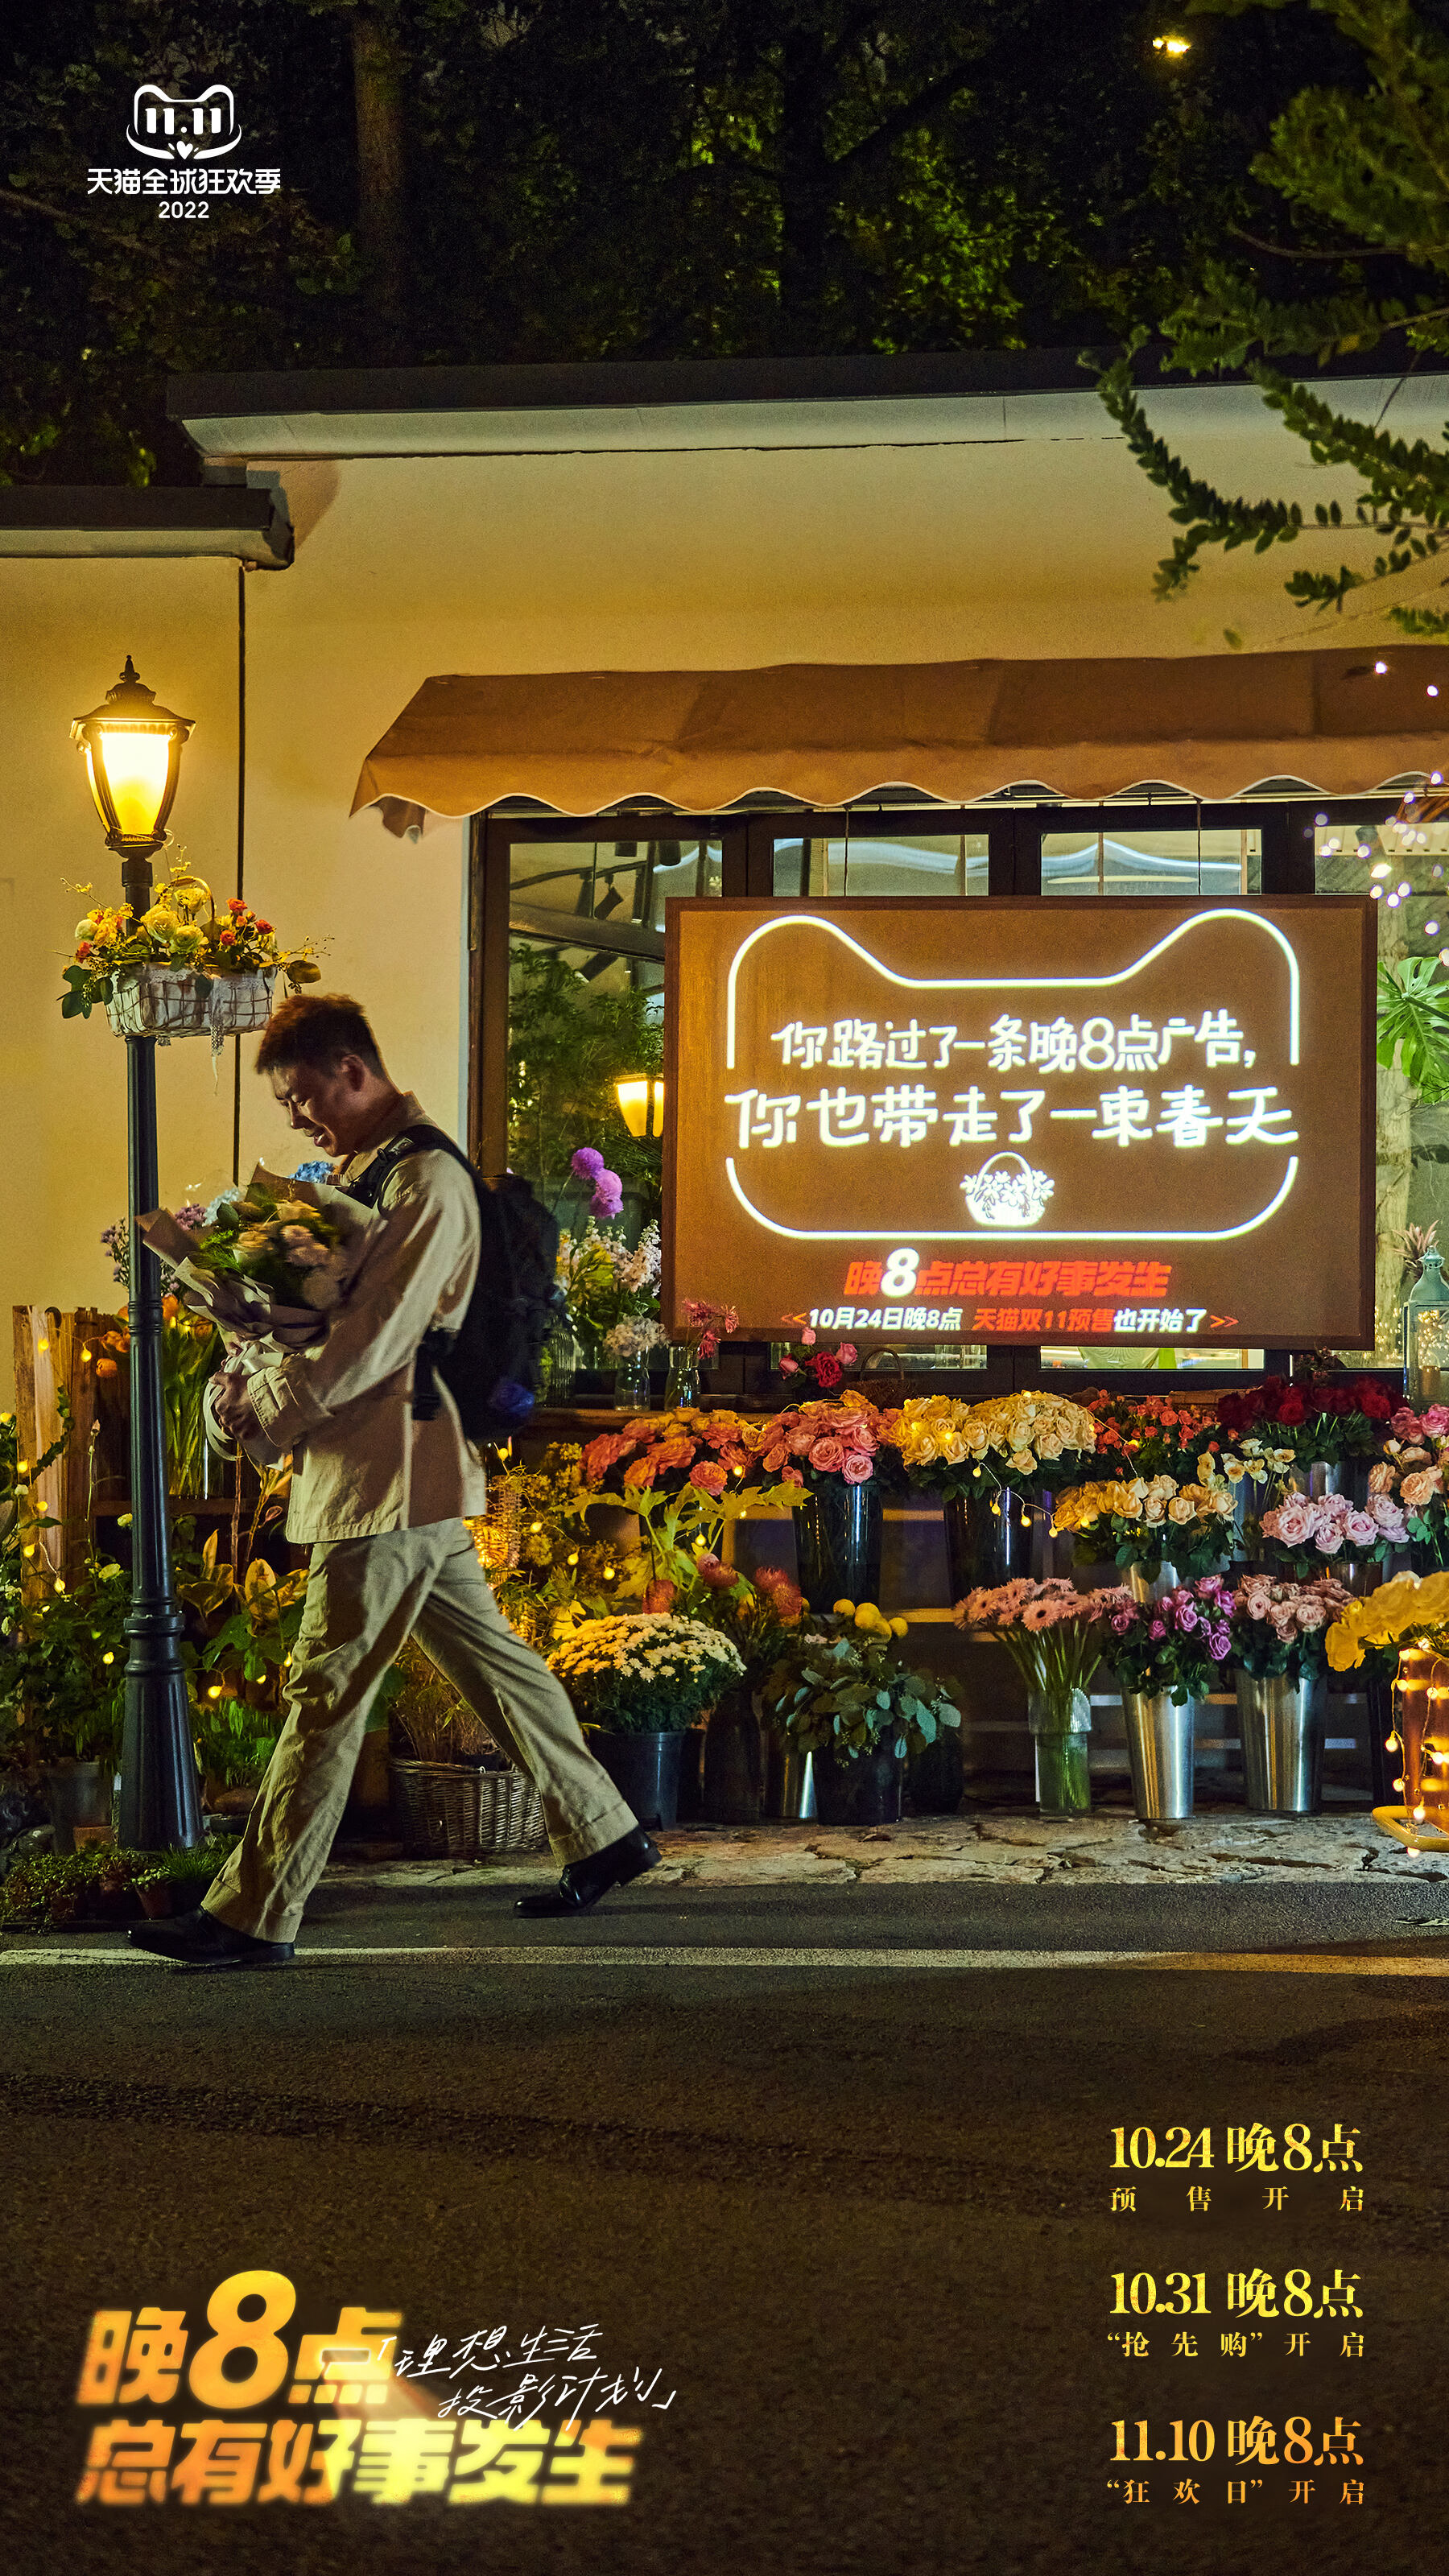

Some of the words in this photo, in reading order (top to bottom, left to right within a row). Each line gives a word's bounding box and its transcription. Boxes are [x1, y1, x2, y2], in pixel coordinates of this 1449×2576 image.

[724, 1084, 1299, 1149] 你也带走了一束春天
[844, 1247, 1172, 1298] 晚8点总有好事发生
[808, 1307, 963, 1331] 10月24日晚8点
